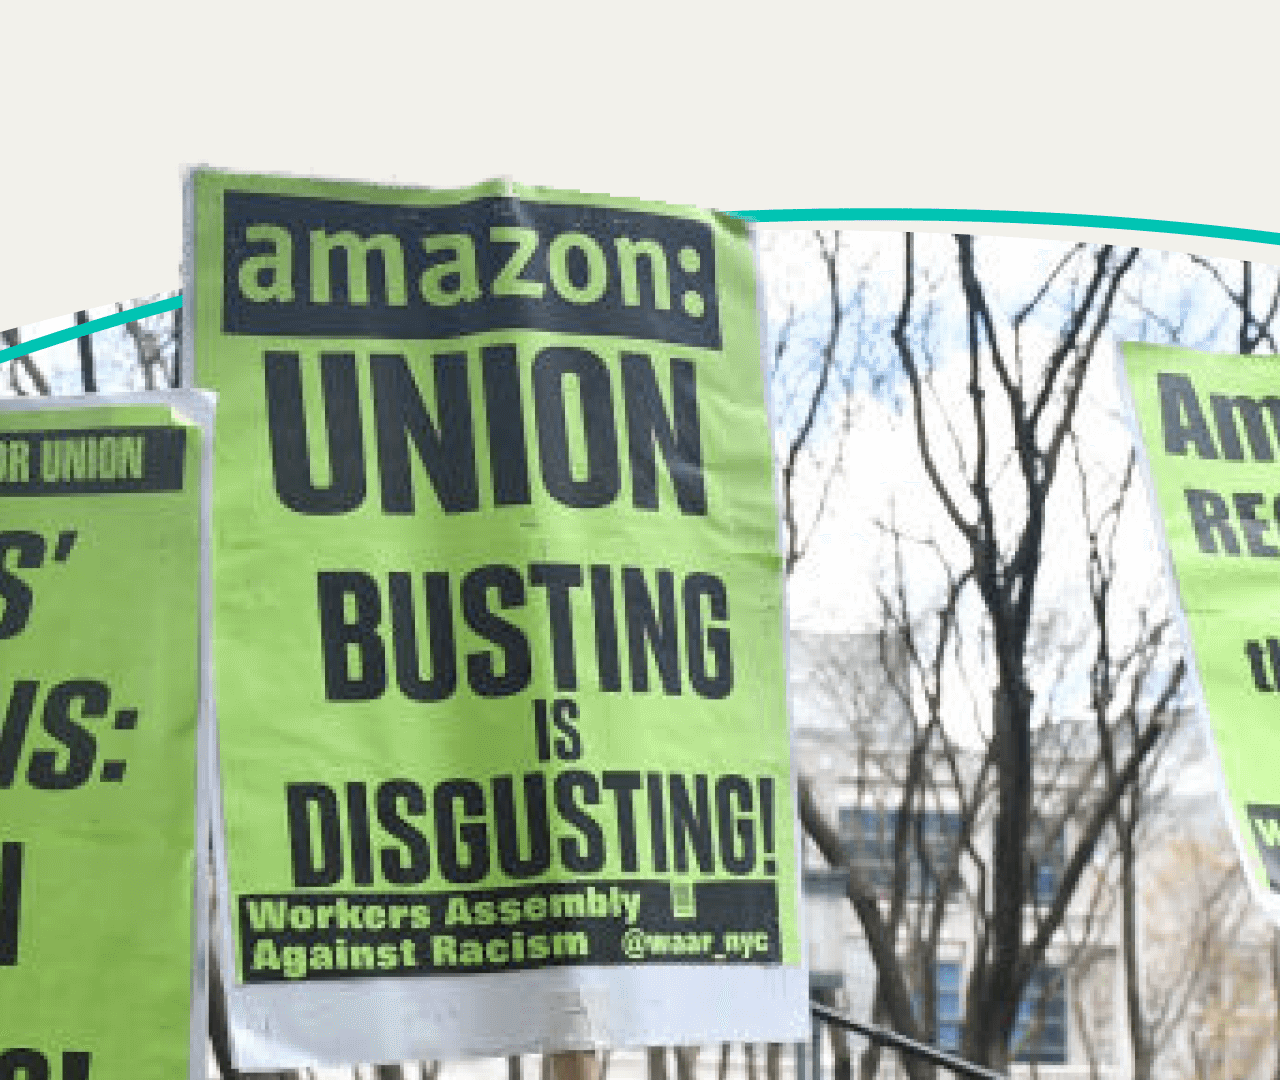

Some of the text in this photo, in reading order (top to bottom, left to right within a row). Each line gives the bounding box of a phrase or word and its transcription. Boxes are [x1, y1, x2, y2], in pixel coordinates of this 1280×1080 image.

[237, 223, 706, 318] amazon:
[40, 435, 144, 484] UNION
[262, 343, 709, 517] UNION
[316, 562, 735, 703] BUSTING
[532, 697, 582, 762] IS
[284, 769, 779, 888] DISGUSTING!
[247, 885, 642, 933] Workers Assembly
[251, 938, 418, 978] Against
[433, 928, 590, 961] Racism
